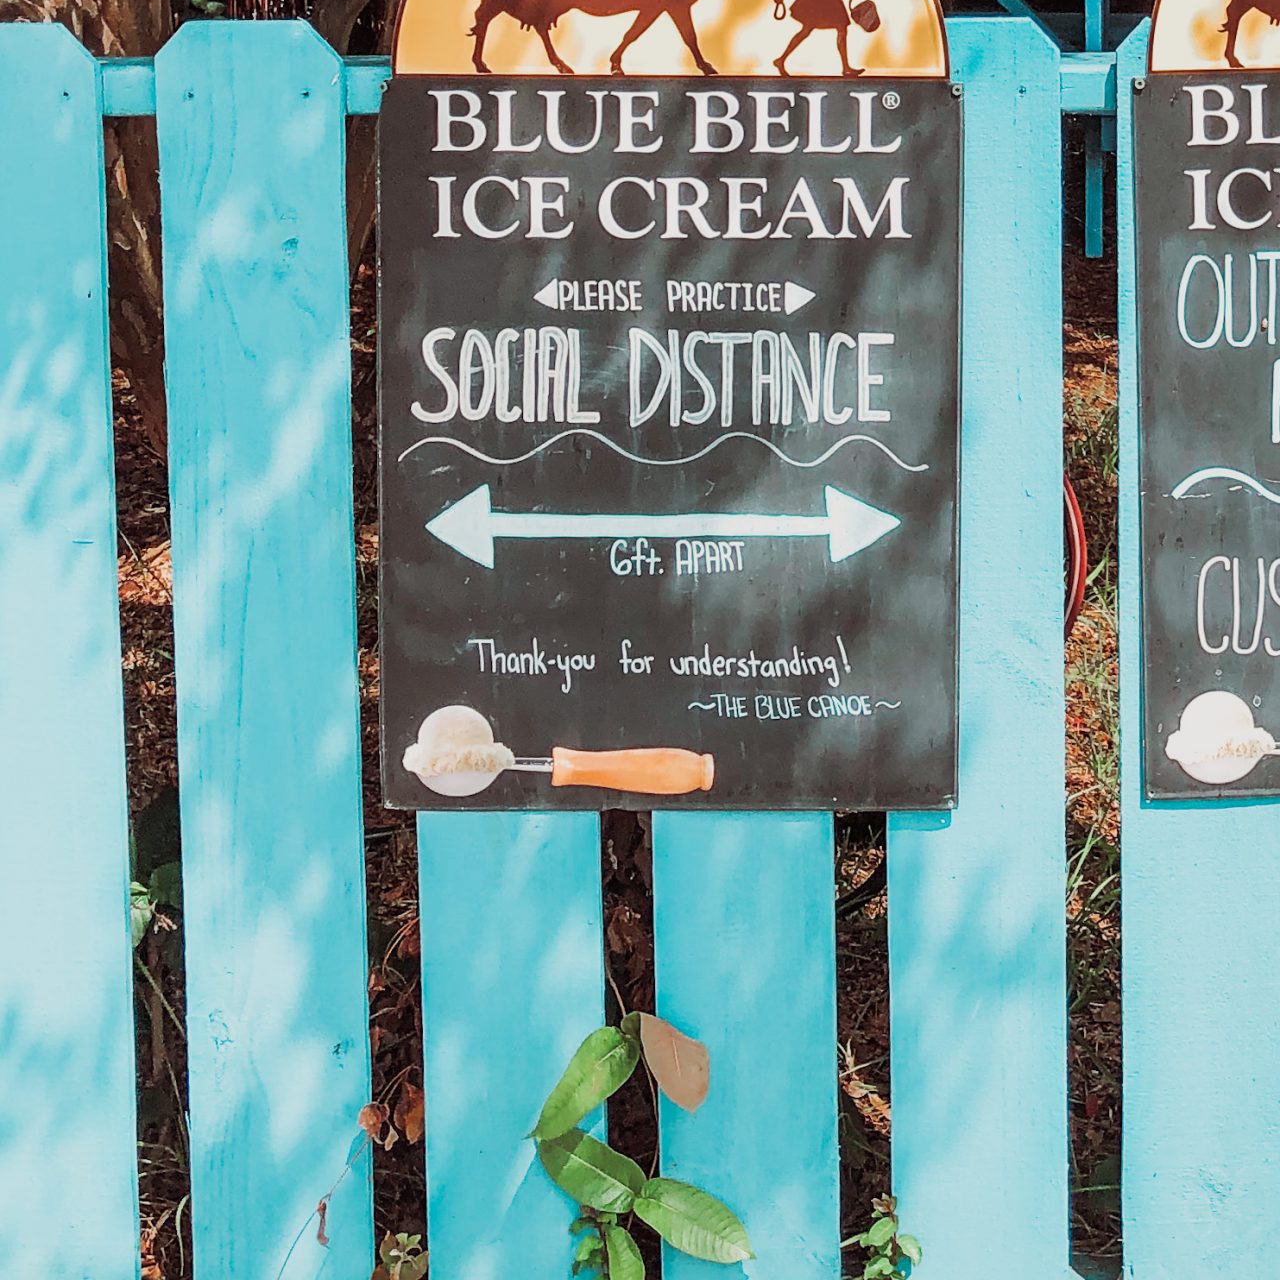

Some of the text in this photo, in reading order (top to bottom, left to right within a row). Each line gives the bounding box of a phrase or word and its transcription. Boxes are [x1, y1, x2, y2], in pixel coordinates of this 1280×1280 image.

[427, 89, 665, 154] BLUE
[428, 175, 913, 241] ICE CREAM
[557, 279, 783, 313] PLEASE PRACTICE
[410, 326, 895, 428] SOCIAL DISTANCE
[675, 539, 745, 575] APART
[467, 635, 852, 693] Thank-you for understanding!
[755, 694, 803, 720] BLUE
